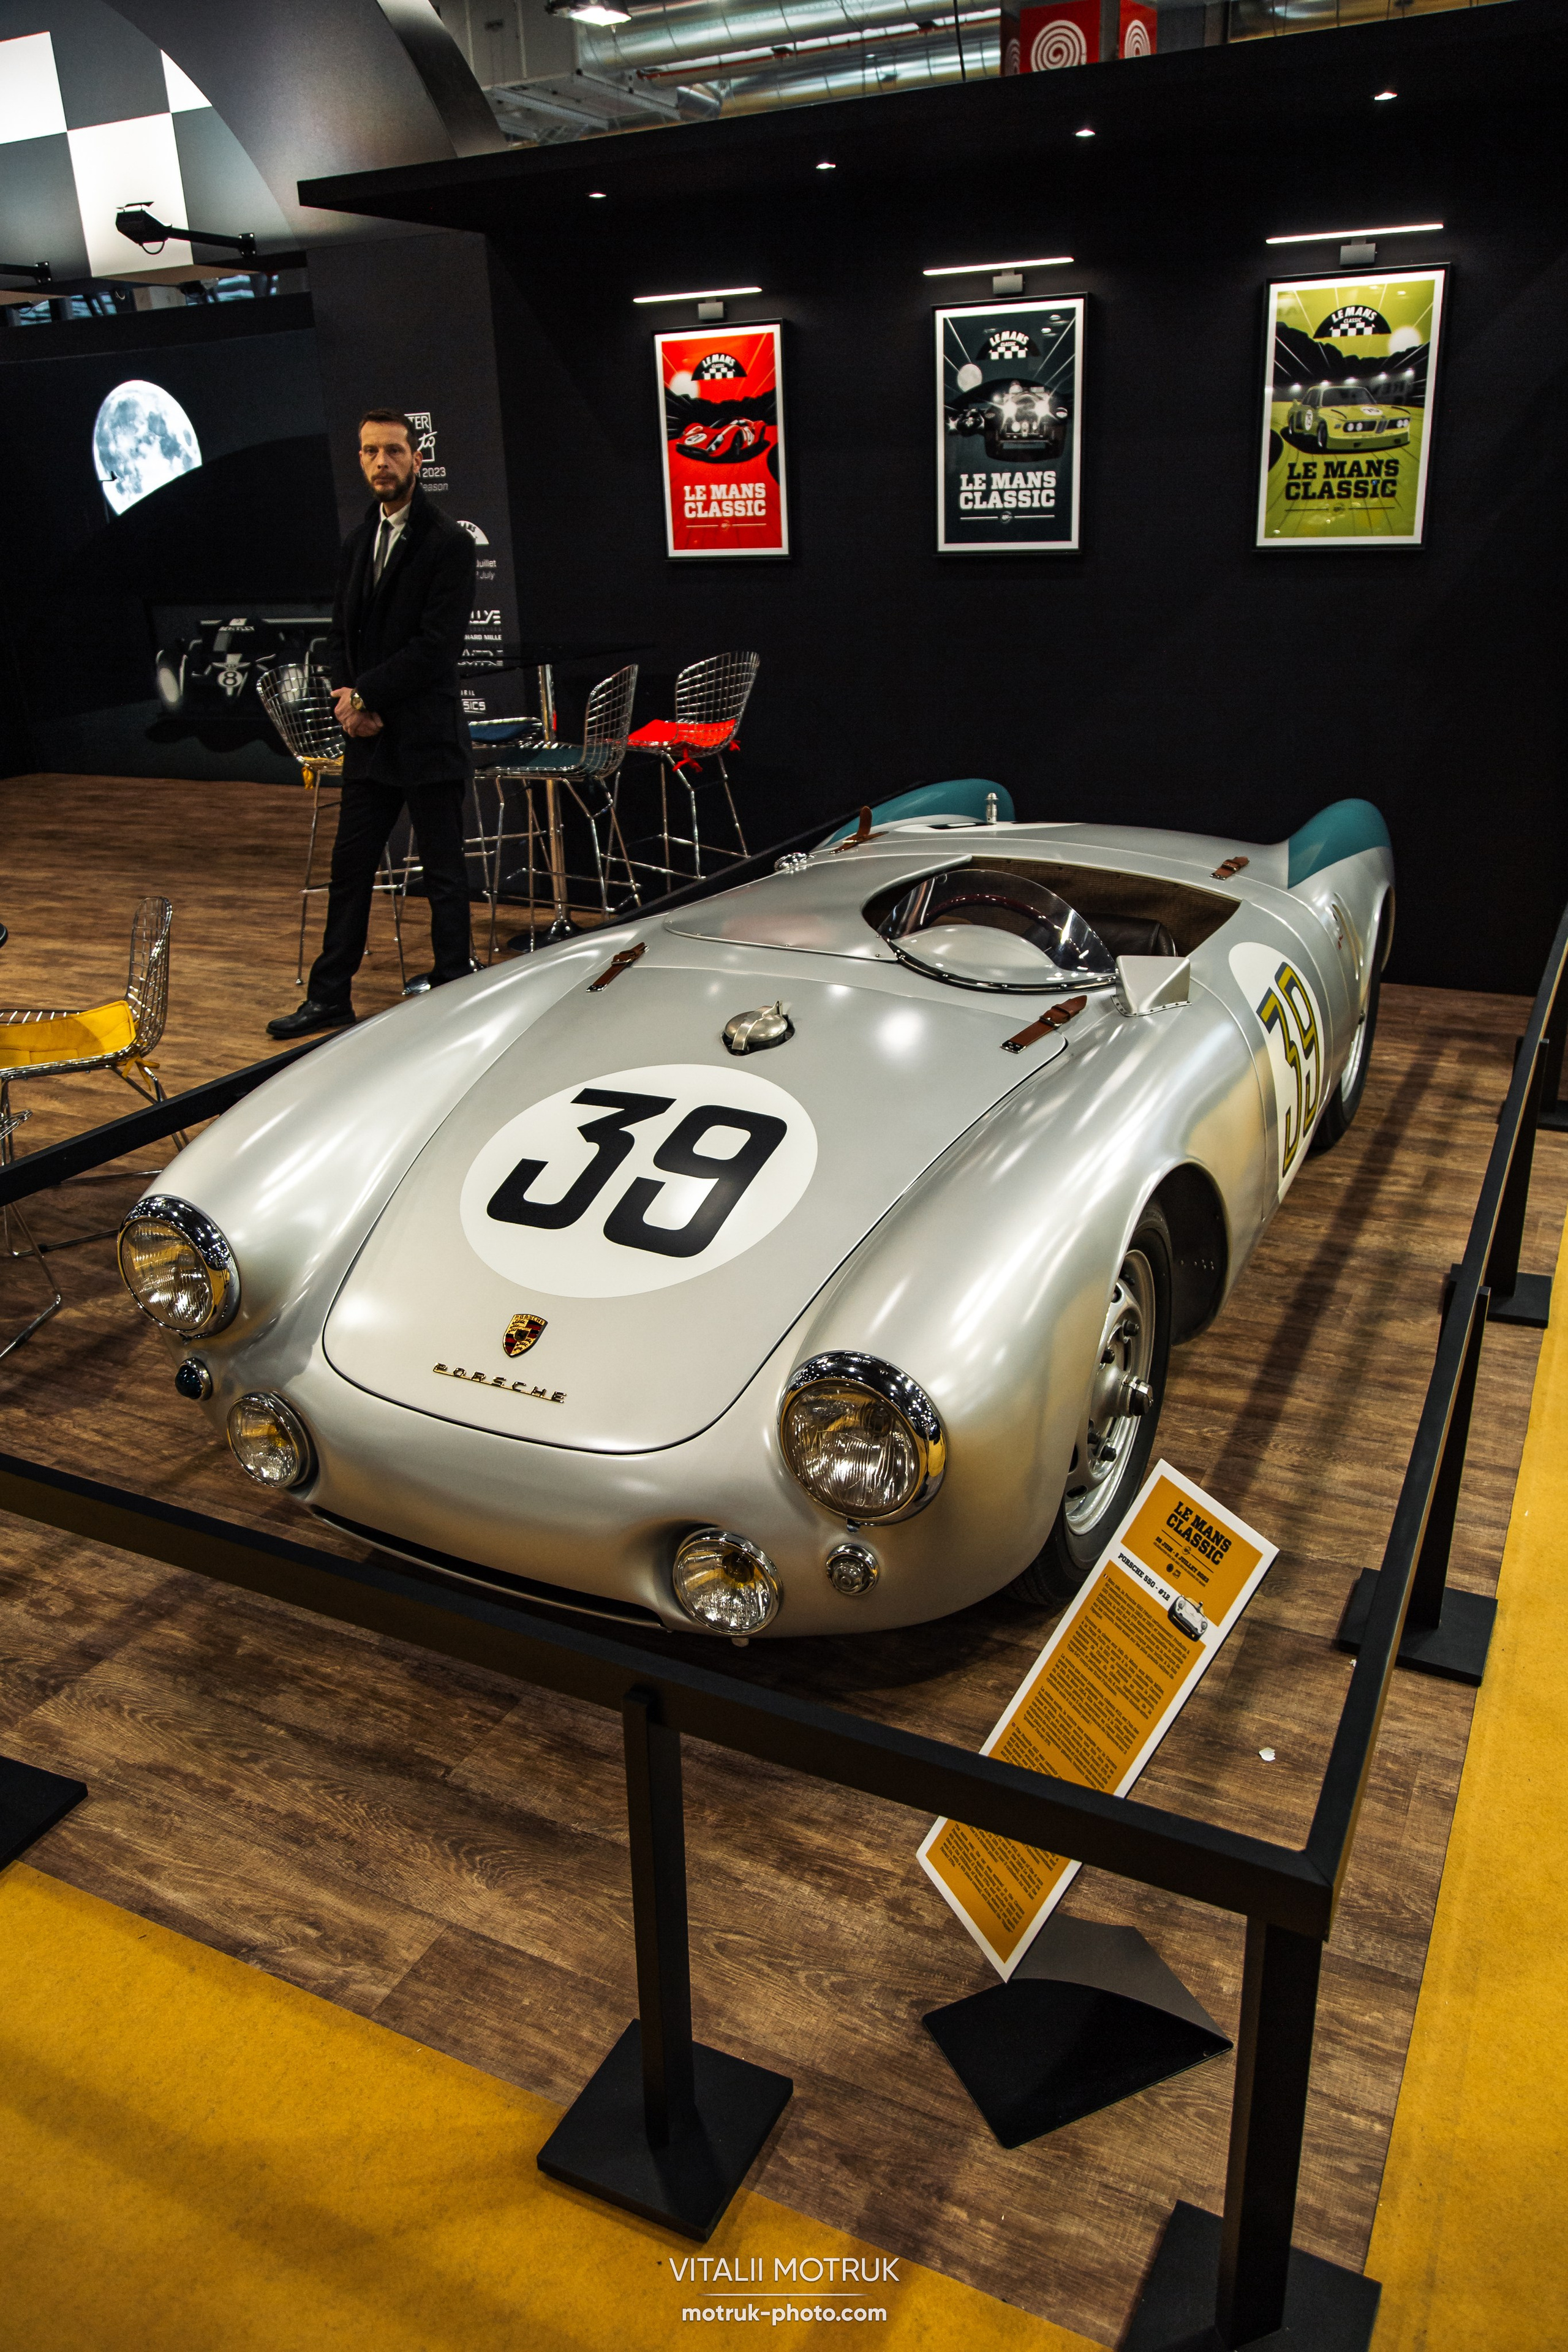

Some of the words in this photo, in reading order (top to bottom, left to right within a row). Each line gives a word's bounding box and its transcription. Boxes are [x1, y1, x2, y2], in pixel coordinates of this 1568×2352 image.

[1332, 309, 1344, 323] LE
[1344, 306, 1378, 322] MANS
[989, 333, 1001, 347] LE
[1001, 331, 1030, 345] MANS
[702, 356, 712, 368] LE
[711, 354, 736, 366] MANS
[422, 467, 447, 477] 2023
[1287, 461, 1317, 480] LE
[1322, 459, 1399, 478] MANS
[960, 473, 986, 491] LE
[991, 470, 1057, 489] MANS
[1285, 478, 1398, 501] CLASSIC
[684, 486, 707, 501] LE
[710, 483, 766, 500] MANS
[960, 488, 1055, 510] CLASSIC
[684, 499, 766, 518] CLASSIC
[222, 671, 238, 686] 8
[1256, 961, 1320, 1178] 39
[486, 1088, 788, 1258] 39
[514, 1314, 545, 1325] PORSCHE
[433, 1362, 568, 1404] PORSCHE
[1173, 1501, 1193, 1522] LE
[1190, 1514, 1232, 1553] MANS
[1165, 1512, 1224, 1566] CLASSIC
[1117, 1552, 1144, 1578] PORSCHE
[1143, 1575, 1155, 1588] 550
[1158, 1588, 1170, 1601] #12
